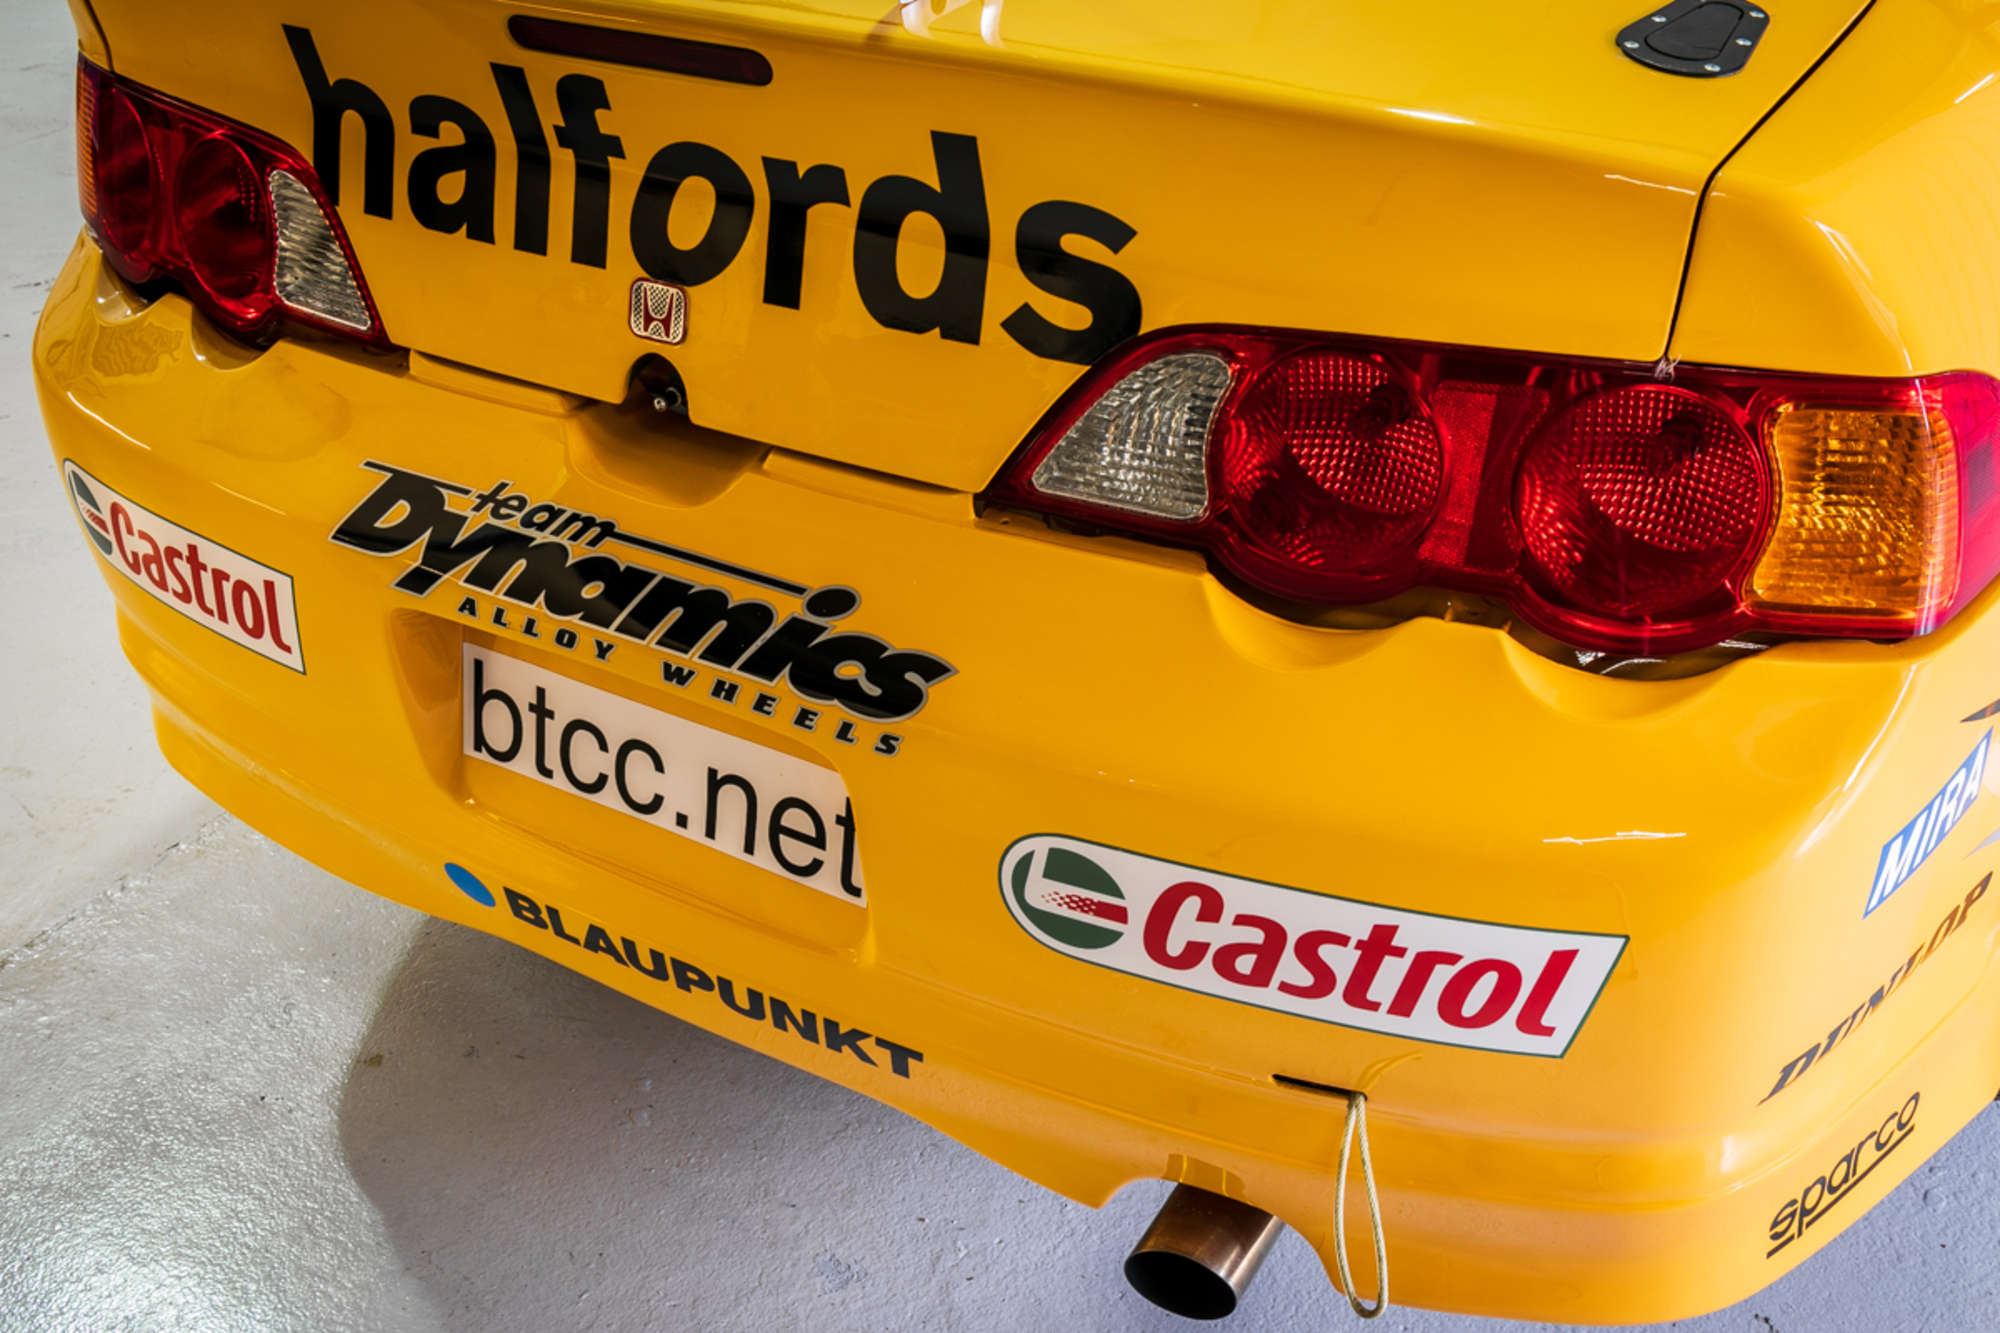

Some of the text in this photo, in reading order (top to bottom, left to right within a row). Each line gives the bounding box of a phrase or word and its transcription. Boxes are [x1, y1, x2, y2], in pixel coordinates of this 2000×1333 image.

[281, 23, 1143, 366] halfords
[110, 501, 293, 655] Castrol
[329, 460, 960, 723] Dynamics
[471, 480, 619, 549] team
[457, 596, 903, 756] ALLOY WHEELS
[472, 658, 863, 899] btcc.net
[1865, 736, 1989, 917] MIRA
[502, 885, 924, 1080] BLAUPUNKT
[1142, 880, 1580, 1037] Castrol
[1768, 1091, 1921, 1241] sparco
